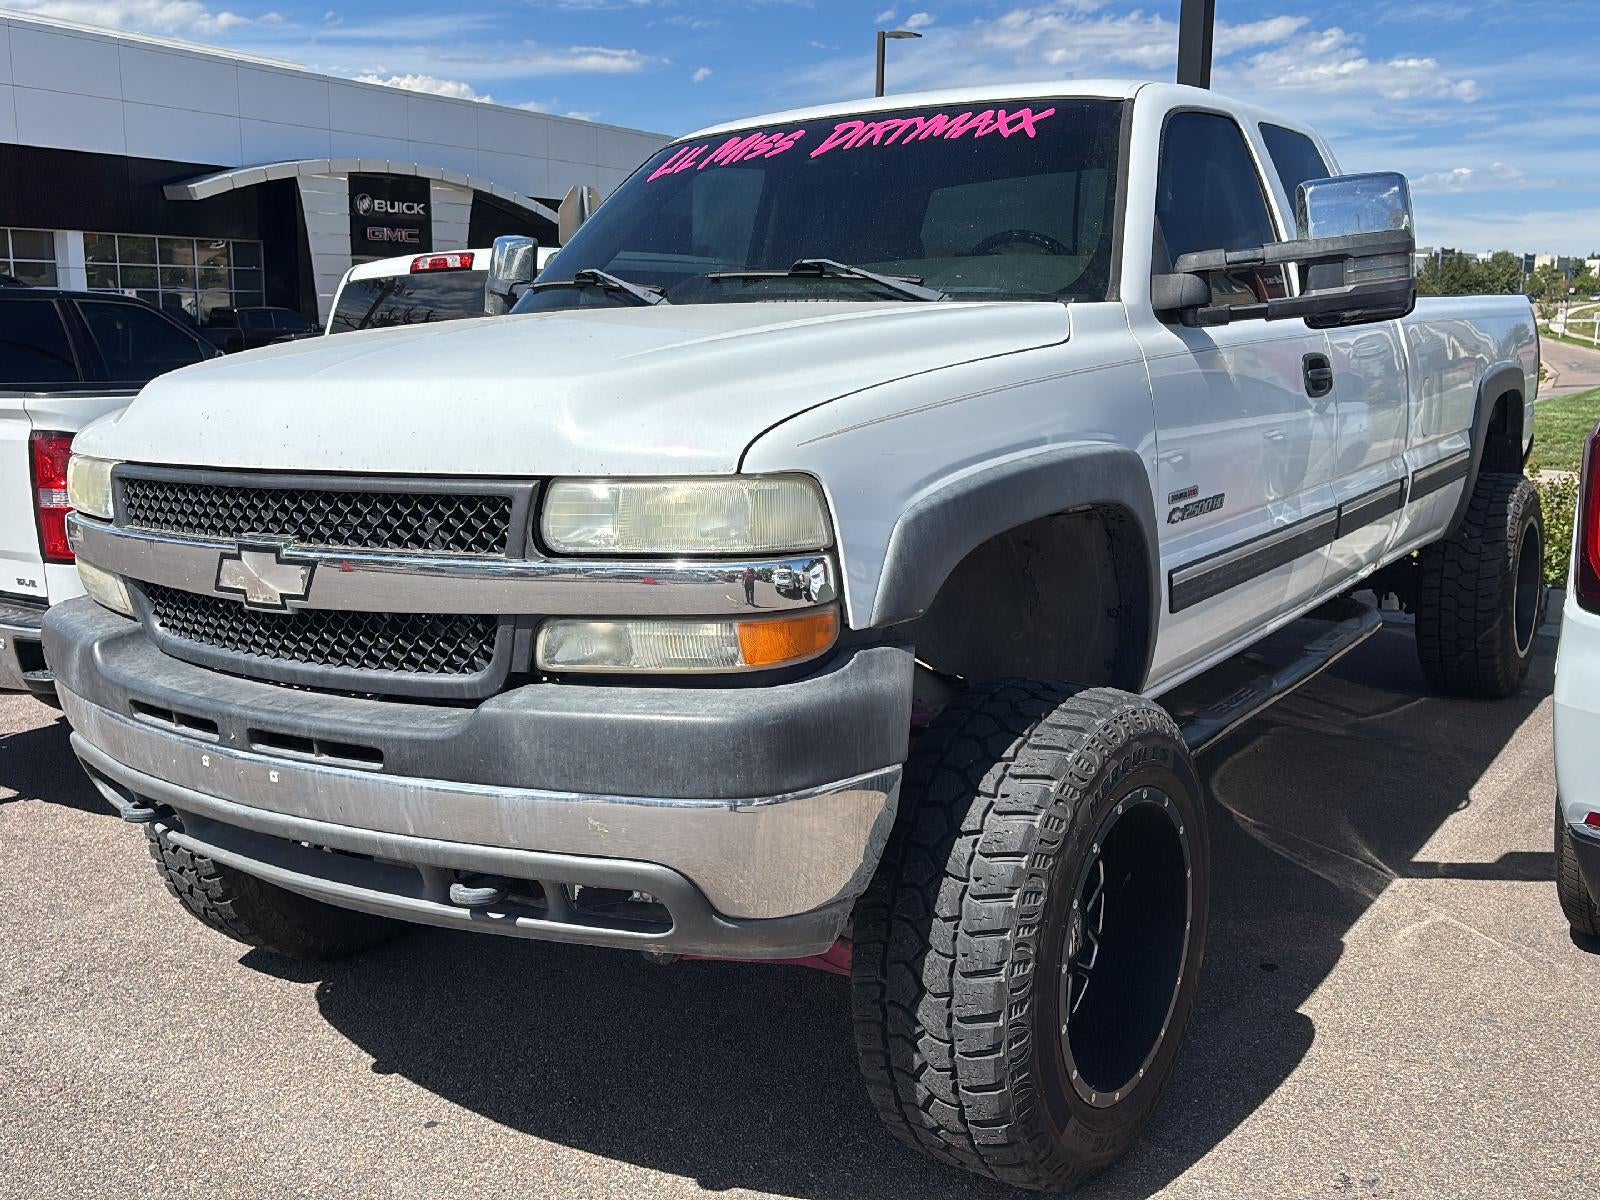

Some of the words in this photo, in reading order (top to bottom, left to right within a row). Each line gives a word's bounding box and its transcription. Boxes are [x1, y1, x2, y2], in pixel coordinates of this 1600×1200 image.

[647, 143, 707, 183] LIL
[697, 129, 806, 170] MISS
[811, 107, 1056, 158] DIRTYMAXX
[373, 199, 426, 215] BUICK
[367, 226, 420, 243] GMC
